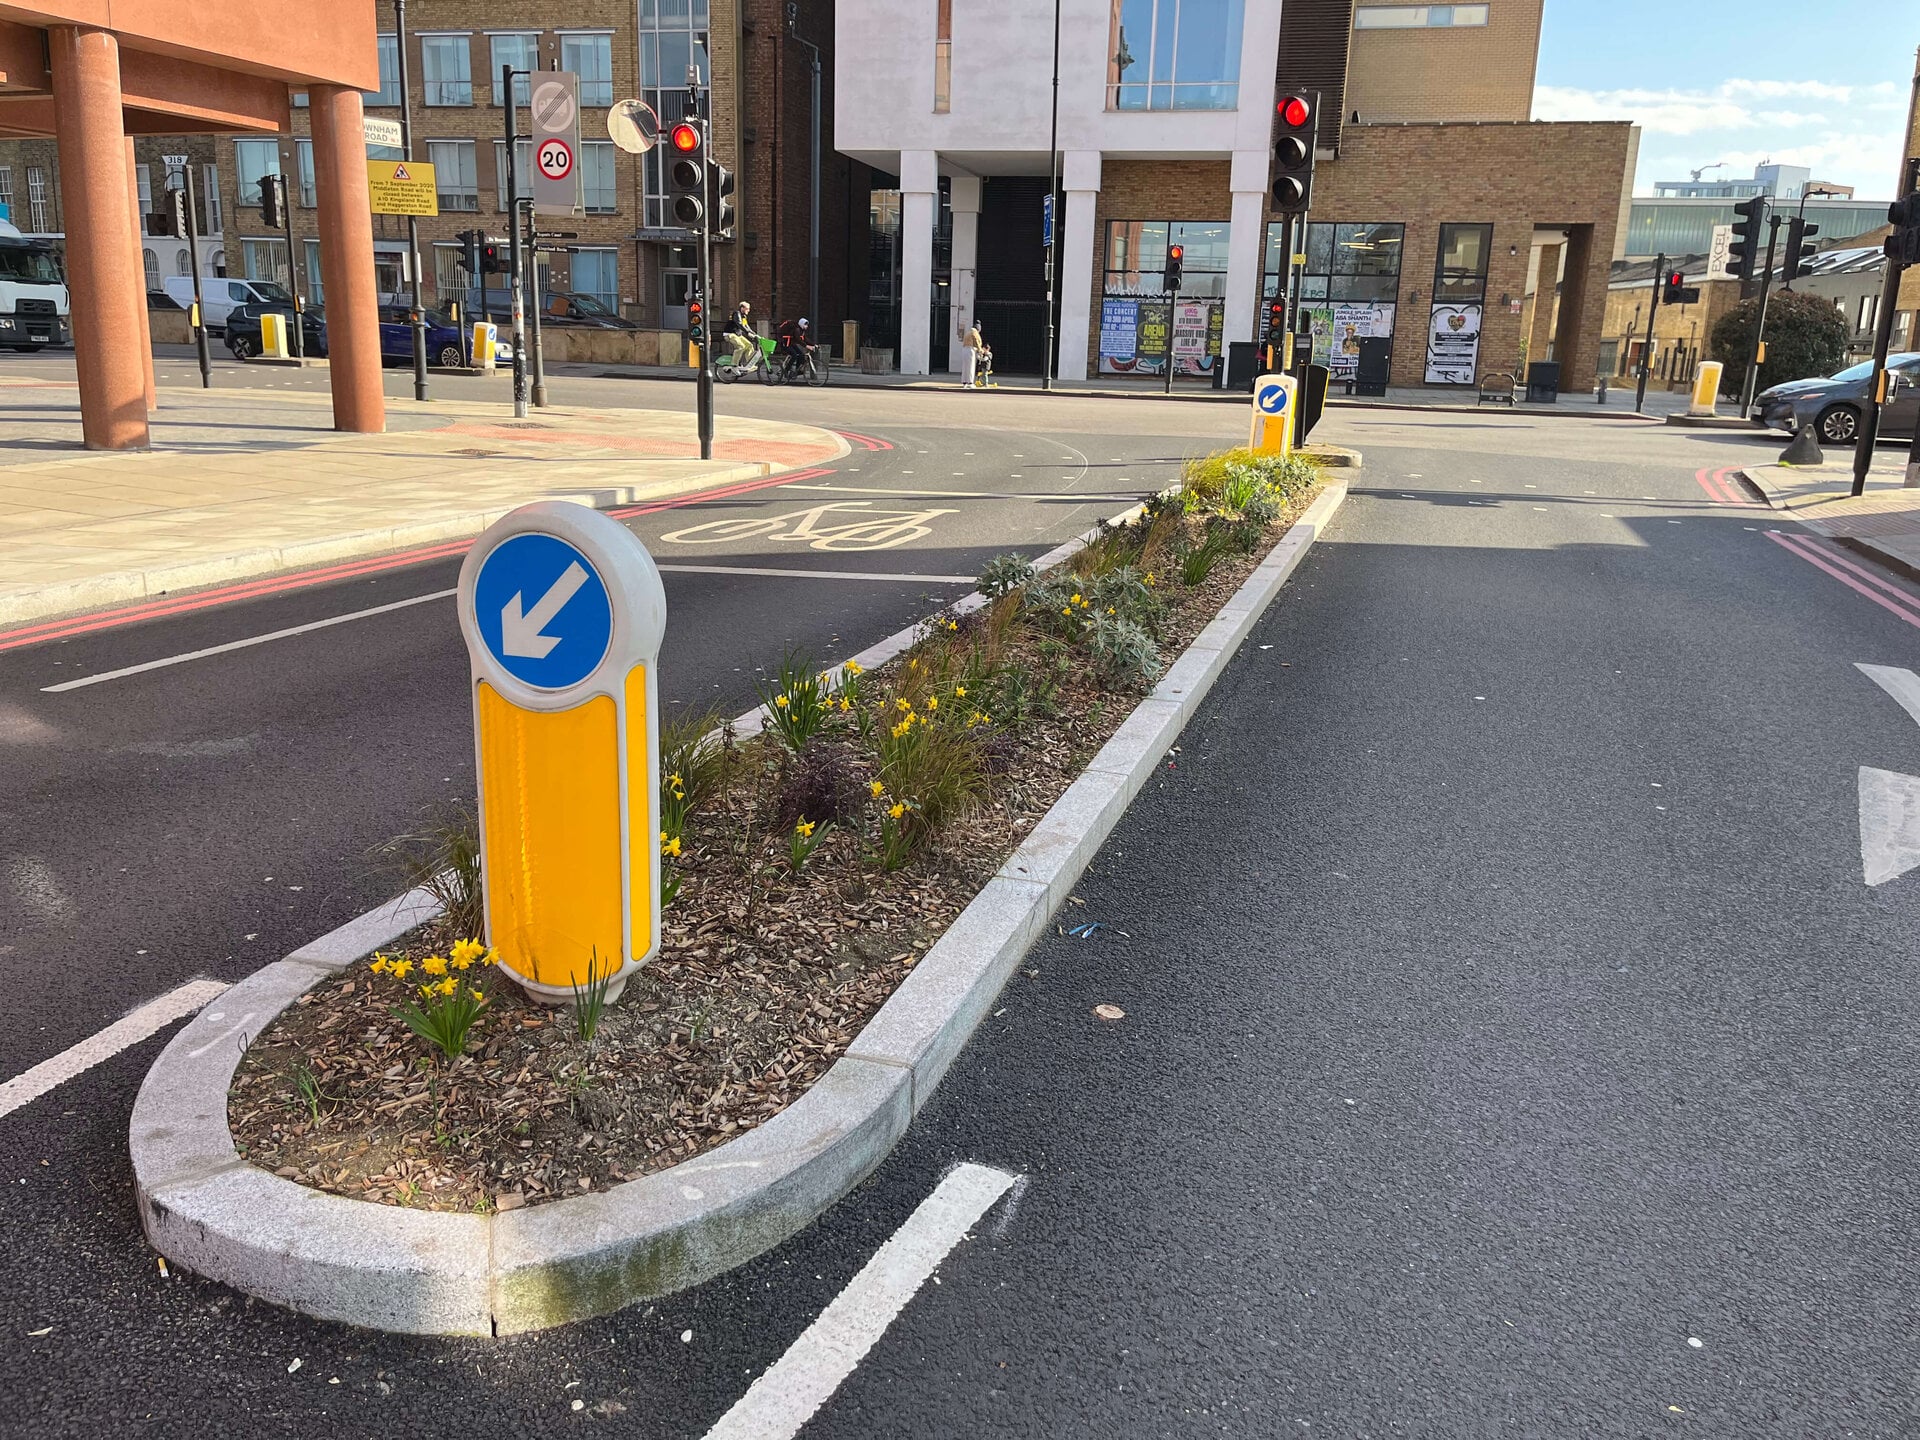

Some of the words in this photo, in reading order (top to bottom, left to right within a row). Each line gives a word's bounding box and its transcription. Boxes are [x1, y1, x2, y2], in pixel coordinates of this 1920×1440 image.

[364, 123, 398, 135] WNHAM
[365, 132, 388, 142] ROAD
[168, 156, 183, 164] 318
[543, 151, 567, 168] 20
[1711, 227, 1727, 272] EXCEL
[1114, 308, 1138, 316] CONCERT
[1175, 330, 1195, 338] MASSIVE
